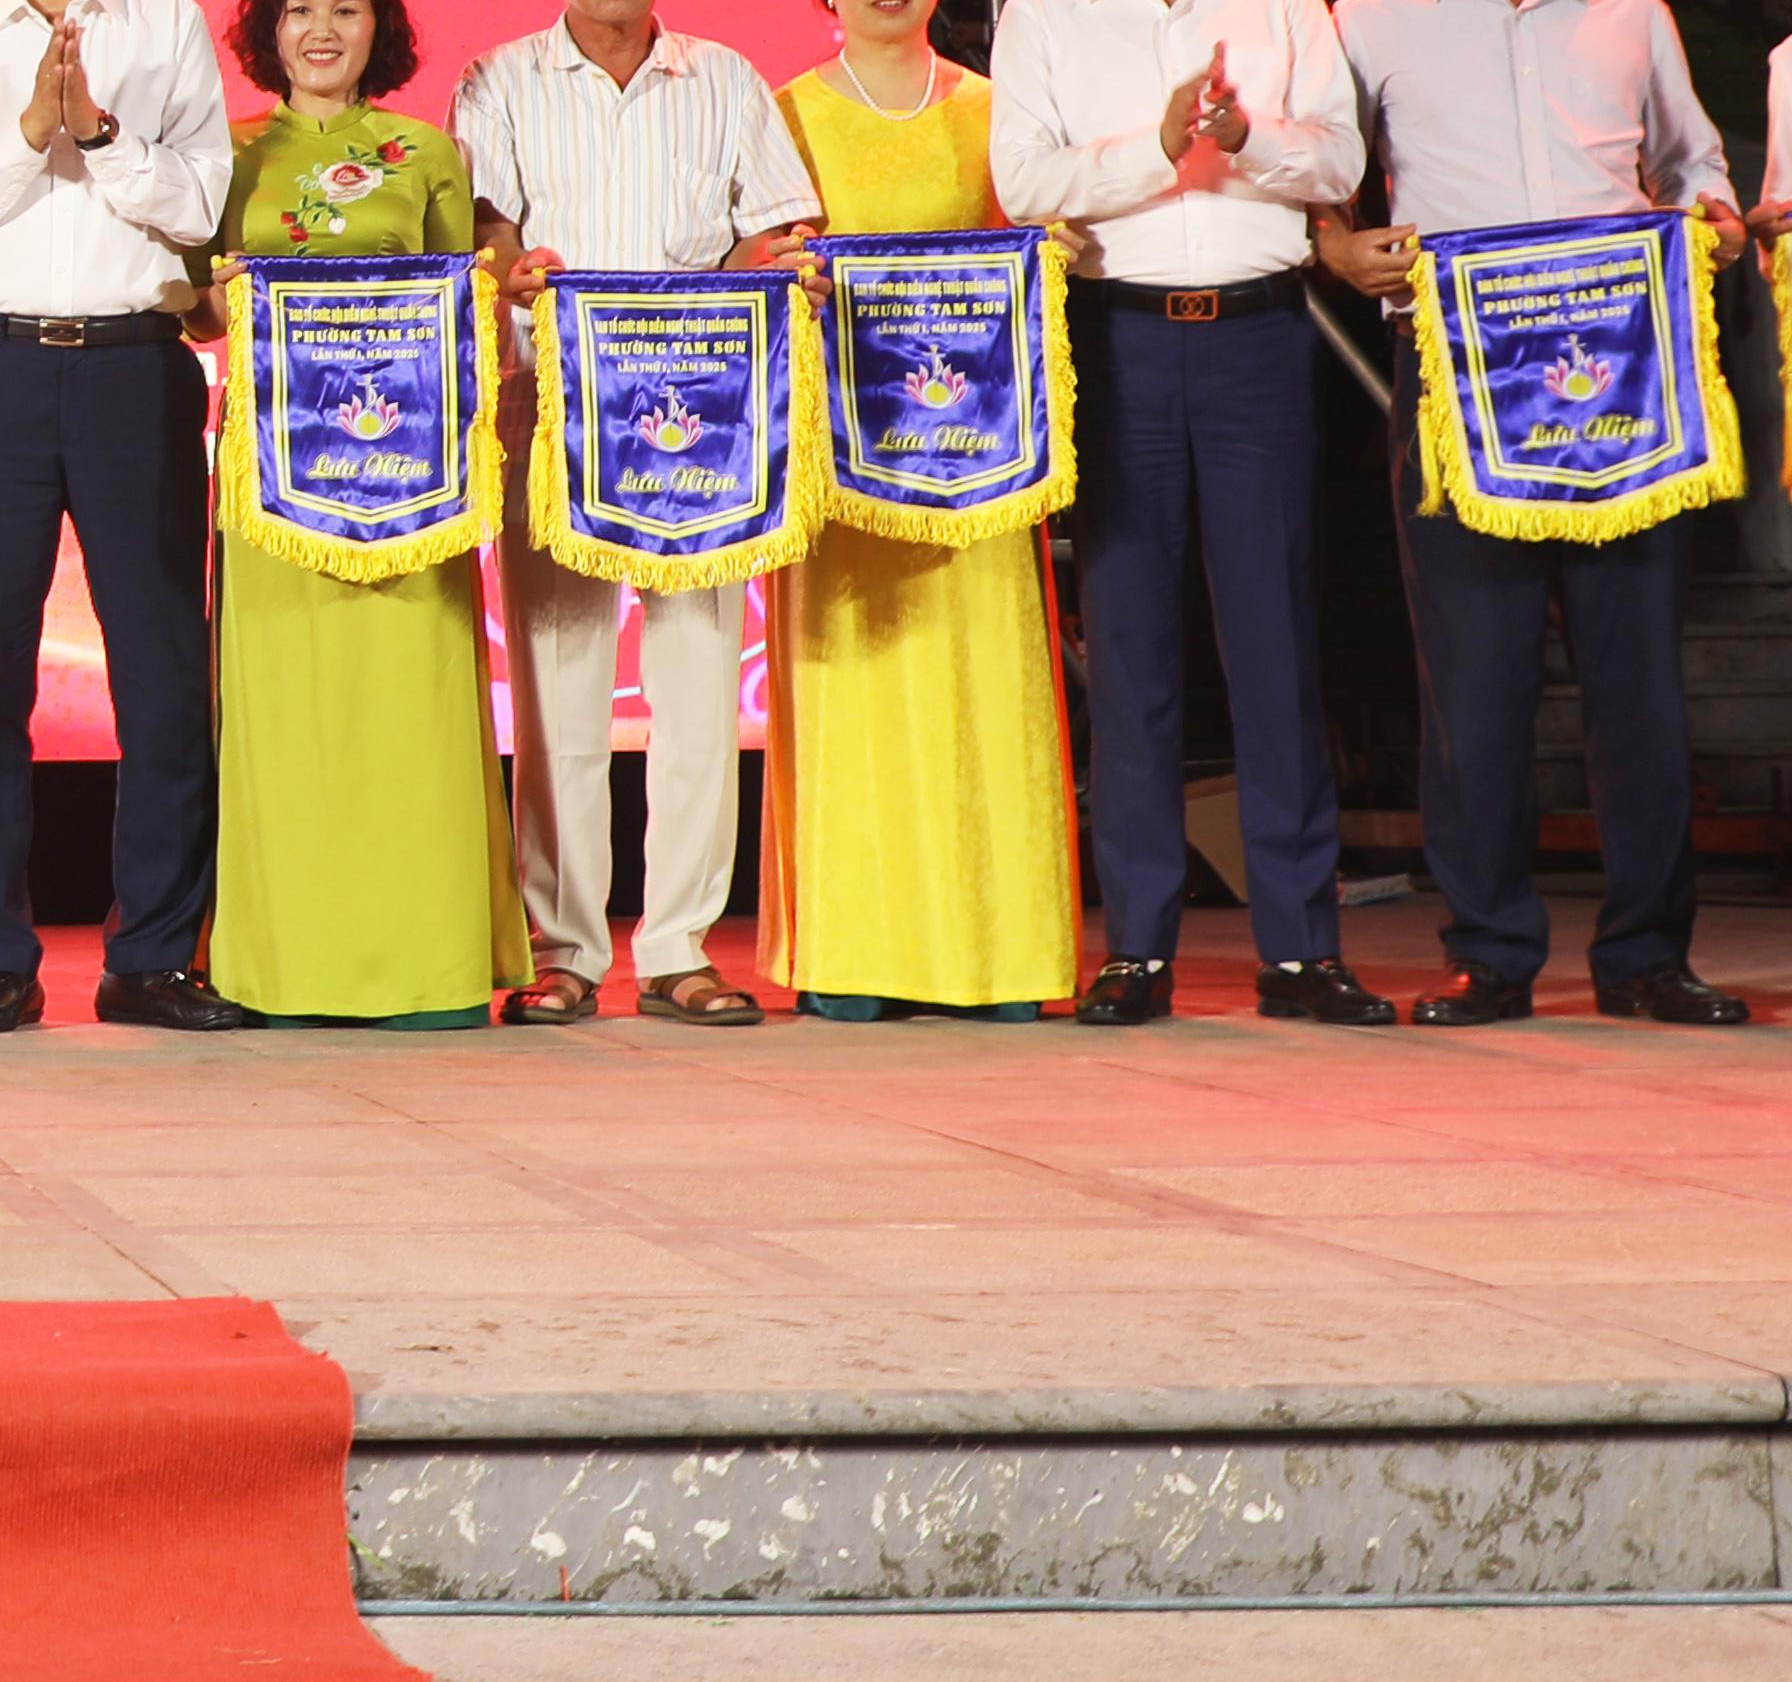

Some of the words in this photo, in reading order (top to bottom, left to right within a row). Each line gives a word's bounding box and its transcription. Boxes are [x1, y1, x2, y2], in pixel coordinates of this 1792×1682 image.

[857, 301, 926, 317] PHƯỜNG
[930, 303, 967, 315] TAM
[972, 300, 1006, 315] SƠN
[292, 327, 361, 342] PHƯỜNG
[366, 329, 402, 341] TAM
[407, 326, 435, 341] SƠN
[599, 340, 667, 355] PHƯỜNG
[672, 341, 708, 355] TAM
[713, 340, 746, 354] SƠN
